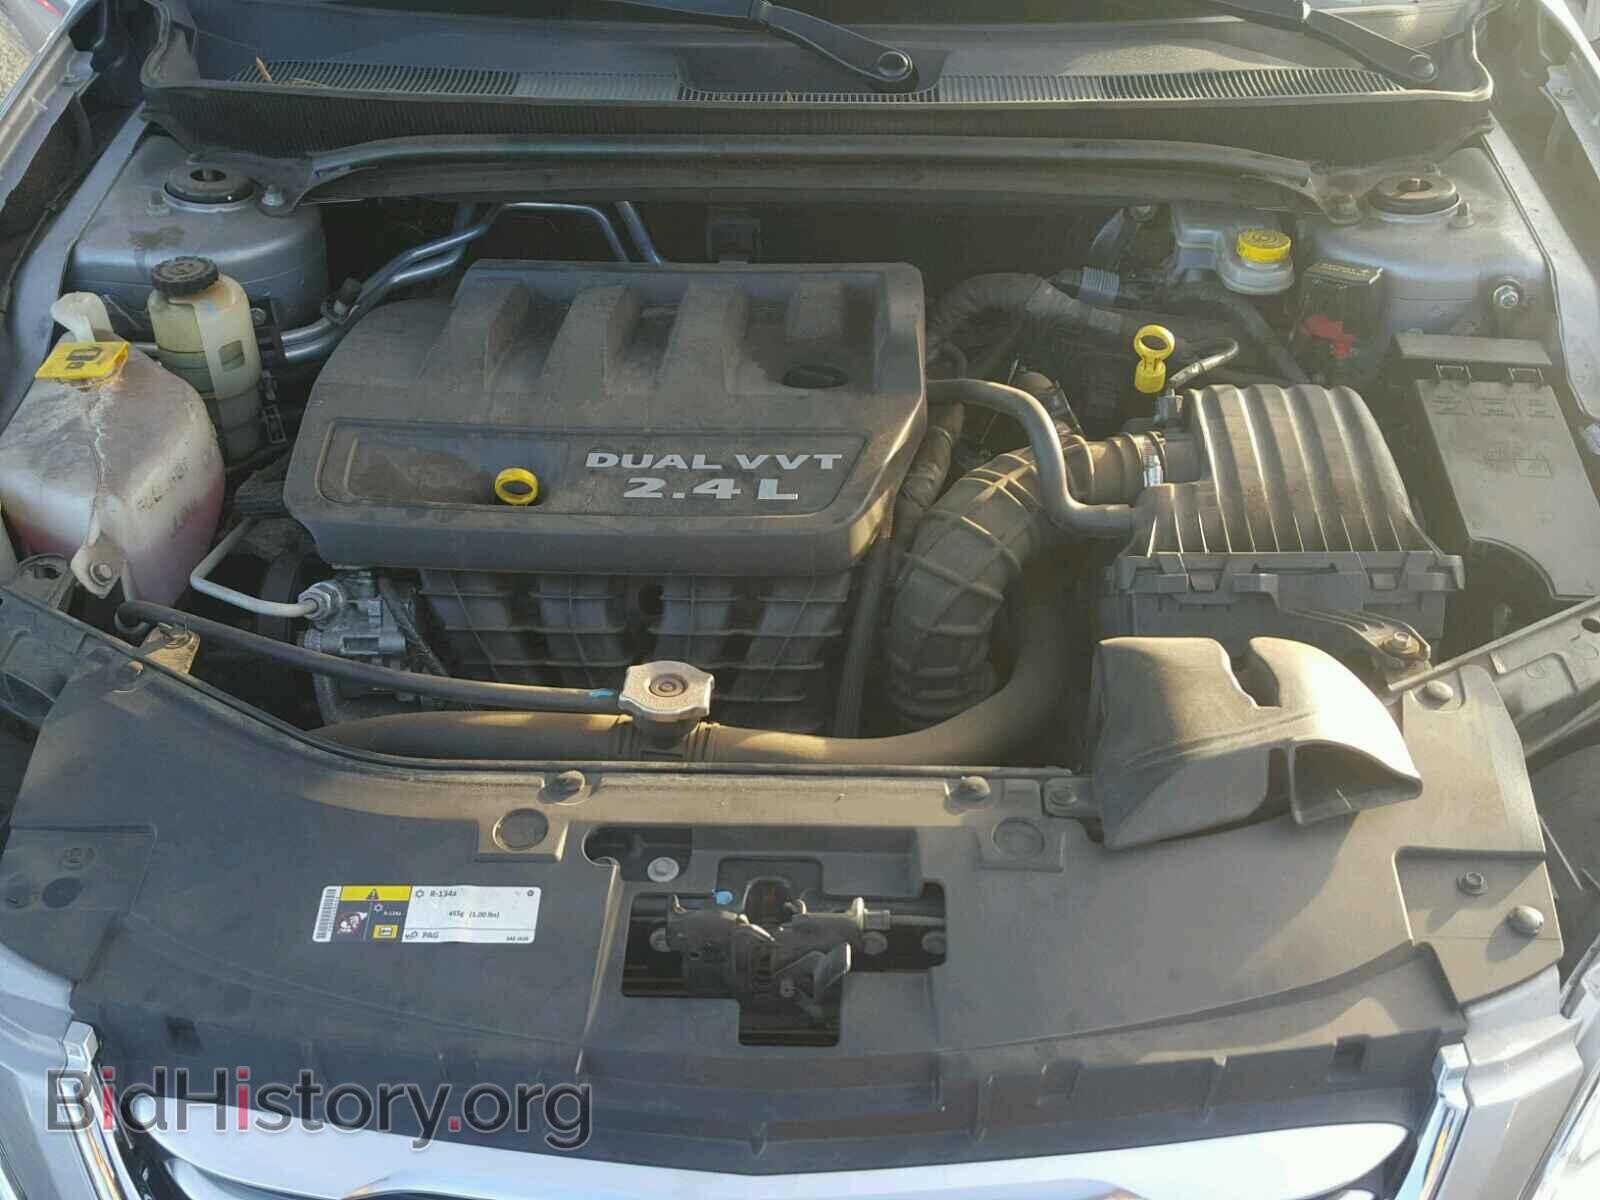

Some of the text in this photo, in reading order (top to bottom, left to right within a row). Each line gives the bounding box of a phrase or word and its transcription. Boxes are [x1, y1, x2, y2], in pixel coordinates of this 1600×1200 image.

[585, 452, 843, 470] DUAL VVT
[623, 477, 742, 499] 2.4
